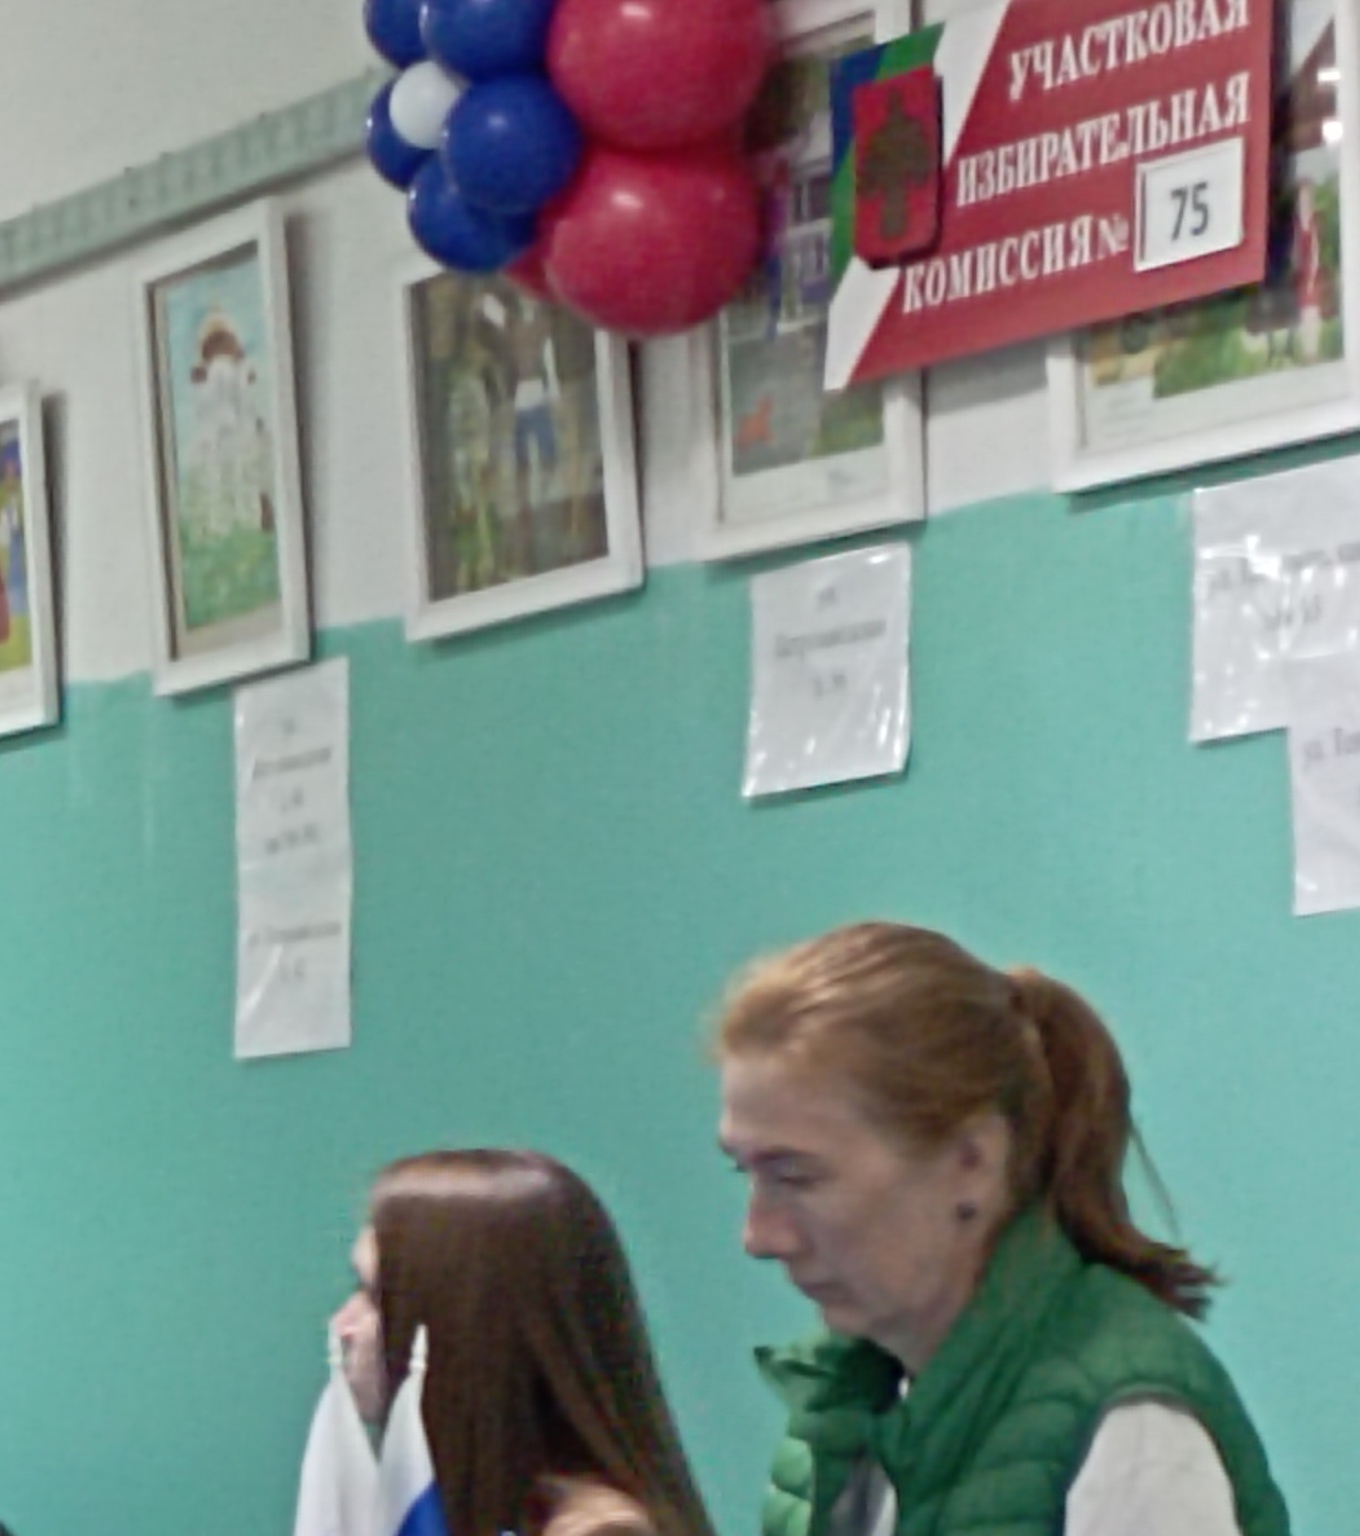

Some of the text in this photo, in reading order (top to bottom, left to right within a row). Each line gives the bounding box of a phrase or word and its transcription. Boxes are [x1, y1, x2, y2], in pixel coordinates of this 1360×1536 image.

[1009, 0, 1251, 101] УЧАСТКОВАЯ
[957, 71, 1251, 207] ИЗБИРАТЕЛЬНАЯ
[1169, 181, 1210, 242] 75
